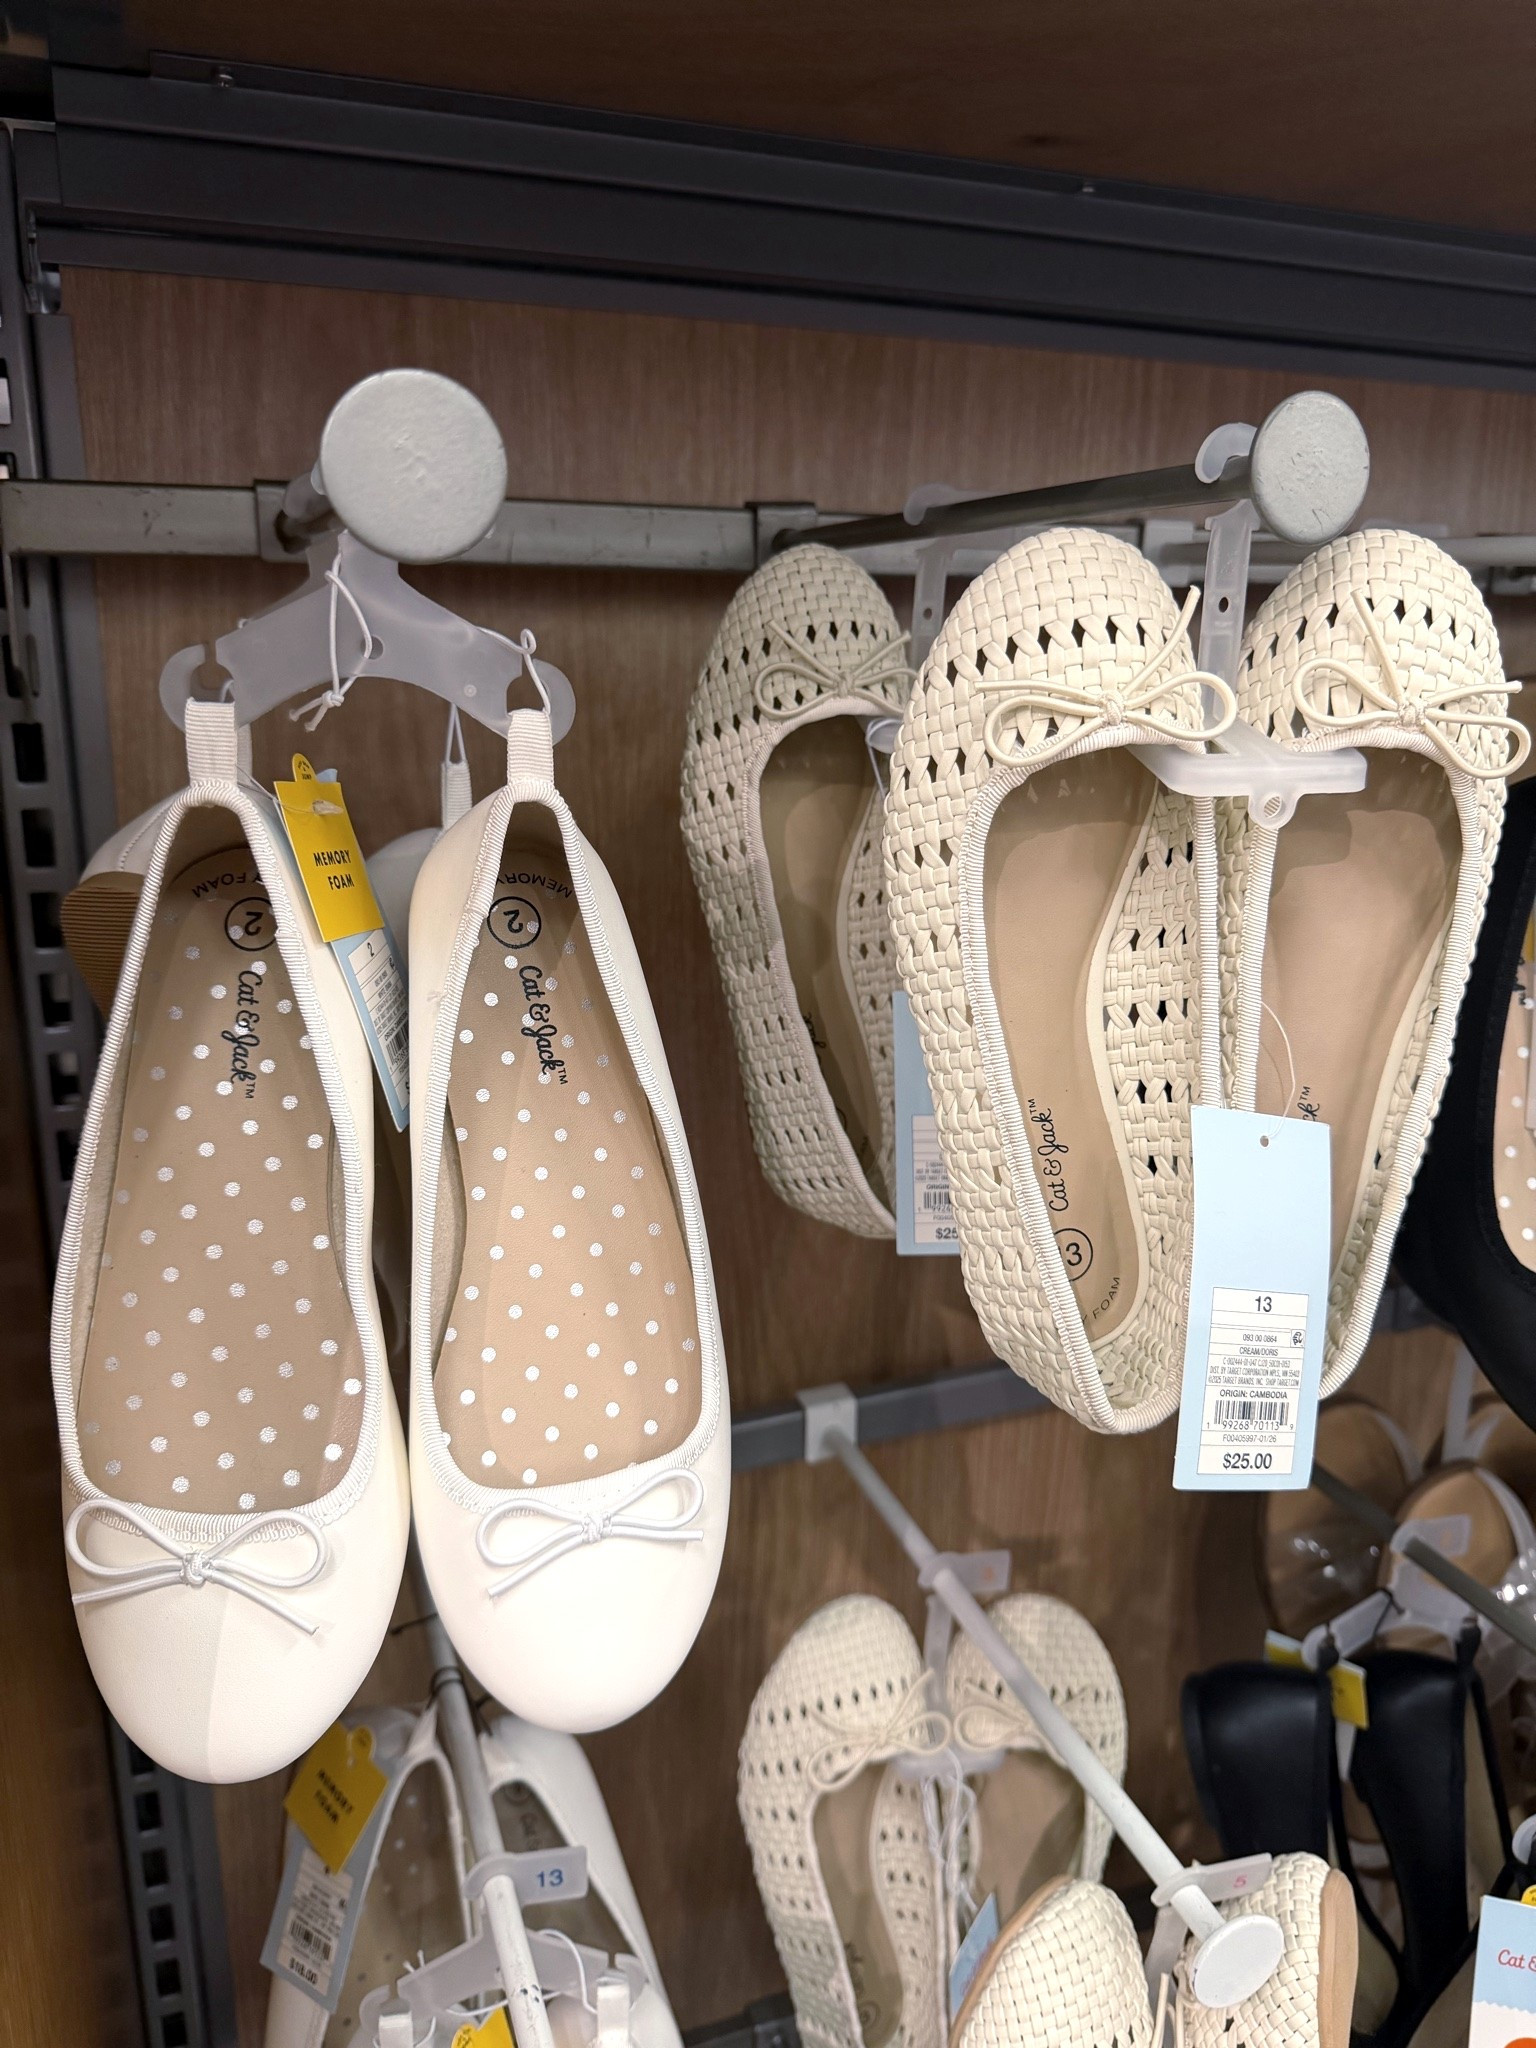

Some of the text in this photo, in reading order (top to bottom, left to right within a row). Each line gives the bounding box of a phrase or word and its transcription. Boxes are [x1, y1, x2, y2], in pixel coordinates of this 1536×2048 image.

[313, 850, 352, 867] MEMORY
[191, 872, 247, 898] FOAM
[328, 873, 355, 890] FOAM
[496, 872, 573, 898] MEMORY
[244, 911, 264, 936] 2
[503, 909, 524, 934] 2
[367, 942, 375, 957] 2
[237, 970, 263, 1006] Cat
[519, 965, 546, 1001] Cat
[236, 1009, 260, 1034] &
[528, 1002, 551, 1023] &
[1043, 1158, 1062, 1177] &
[1047, 1178, 1069, 1212] Cat
[935, 1227, 959, 1240] $25
[1092, 1276, 1120, 1320] FOAM
[1255, 1296, 1272, 1312] 13
[1254, 1334, 1263, 1342] 00
[1239, 1346, 1279, 1356] CREAM/DORIS
[1222, 1375, 1238, 1385] TARGET
[1265, 1378, 1277, 1386] SHOP
[1226, 1366, 1242, 1376] TARGET
[1242, 1367, 1269, 1377] CORPORATION
[1219, 1389, 1288, 1399] ORIGIN: CAMBODIA
[1222, 1420, 1250, 1430] 99268
[1253, 1420, 1280, 1431] 70113
[1222, 1452, 1273, 1470] $25.00
[536, 1868, 564, 1888] 13
[1233, 1874, 1248, 1888] 5
[1498, 1948, 1526, 1970] Cat
